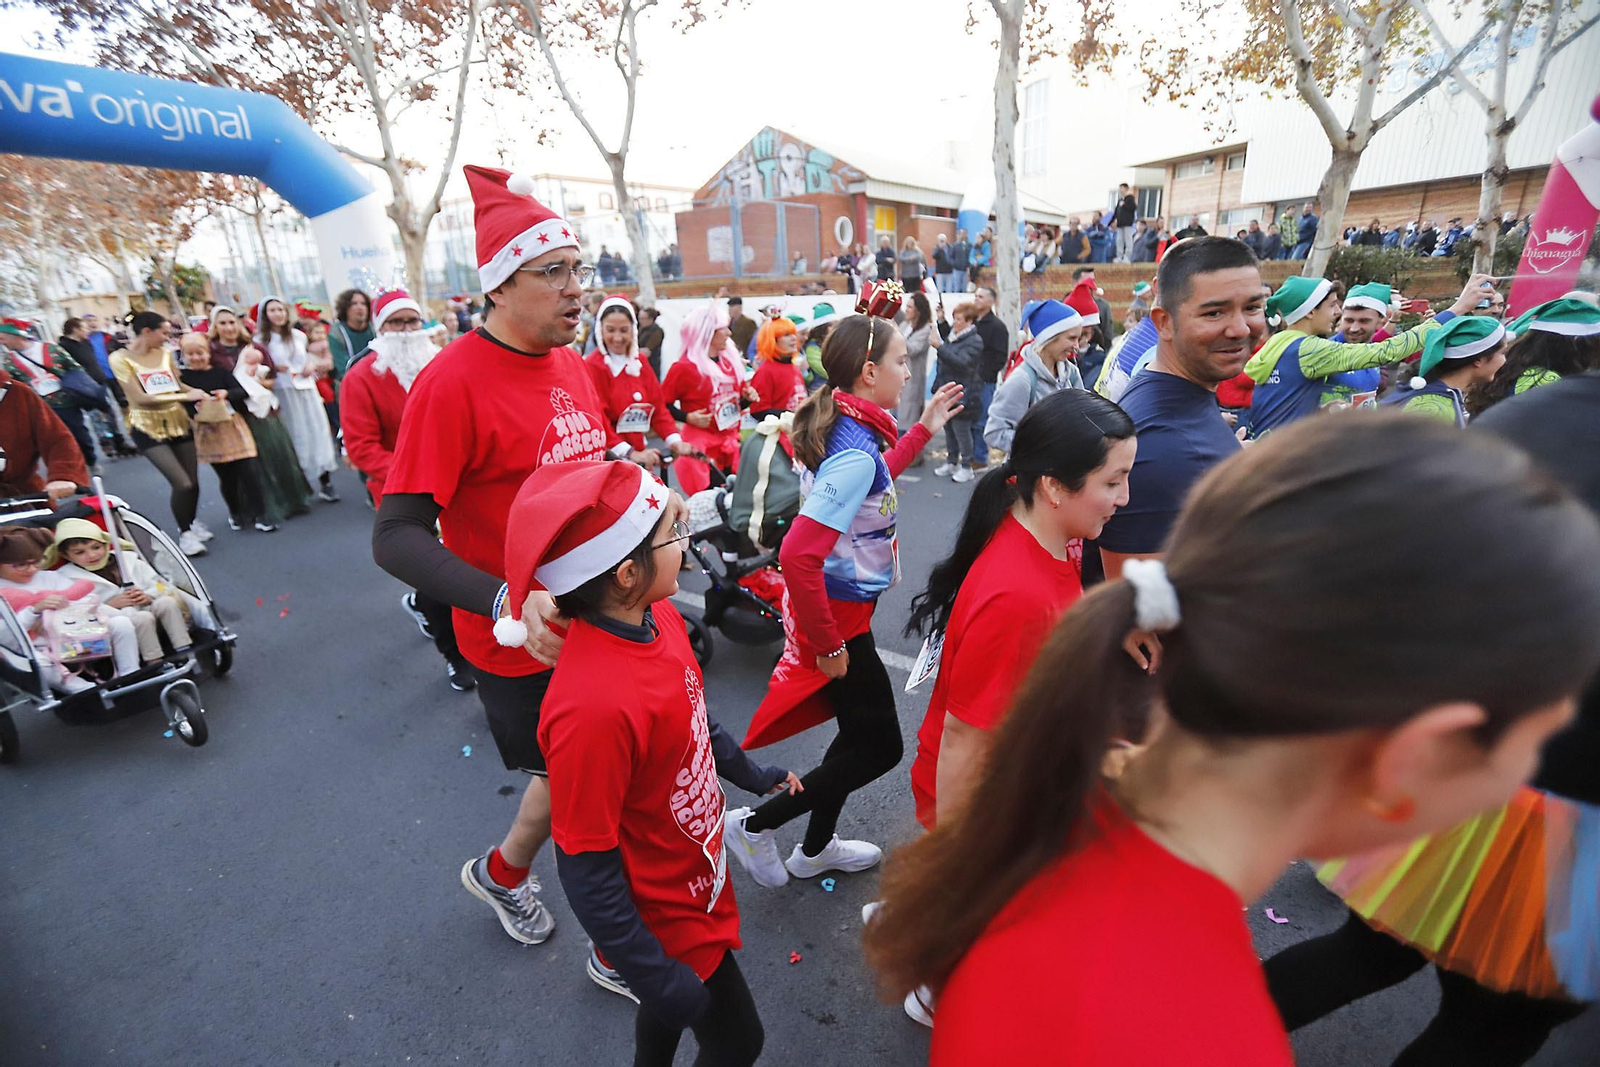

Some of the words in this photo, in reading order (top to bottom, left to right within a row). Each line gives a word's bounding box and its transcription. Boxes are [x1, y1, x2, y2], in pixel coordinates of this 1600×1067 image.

[0, 79, 76, 119] va
[88, 89, 253, 142] original
[552, 411, 592, 438] XIII
[688, 873, 714, 898] Hu
